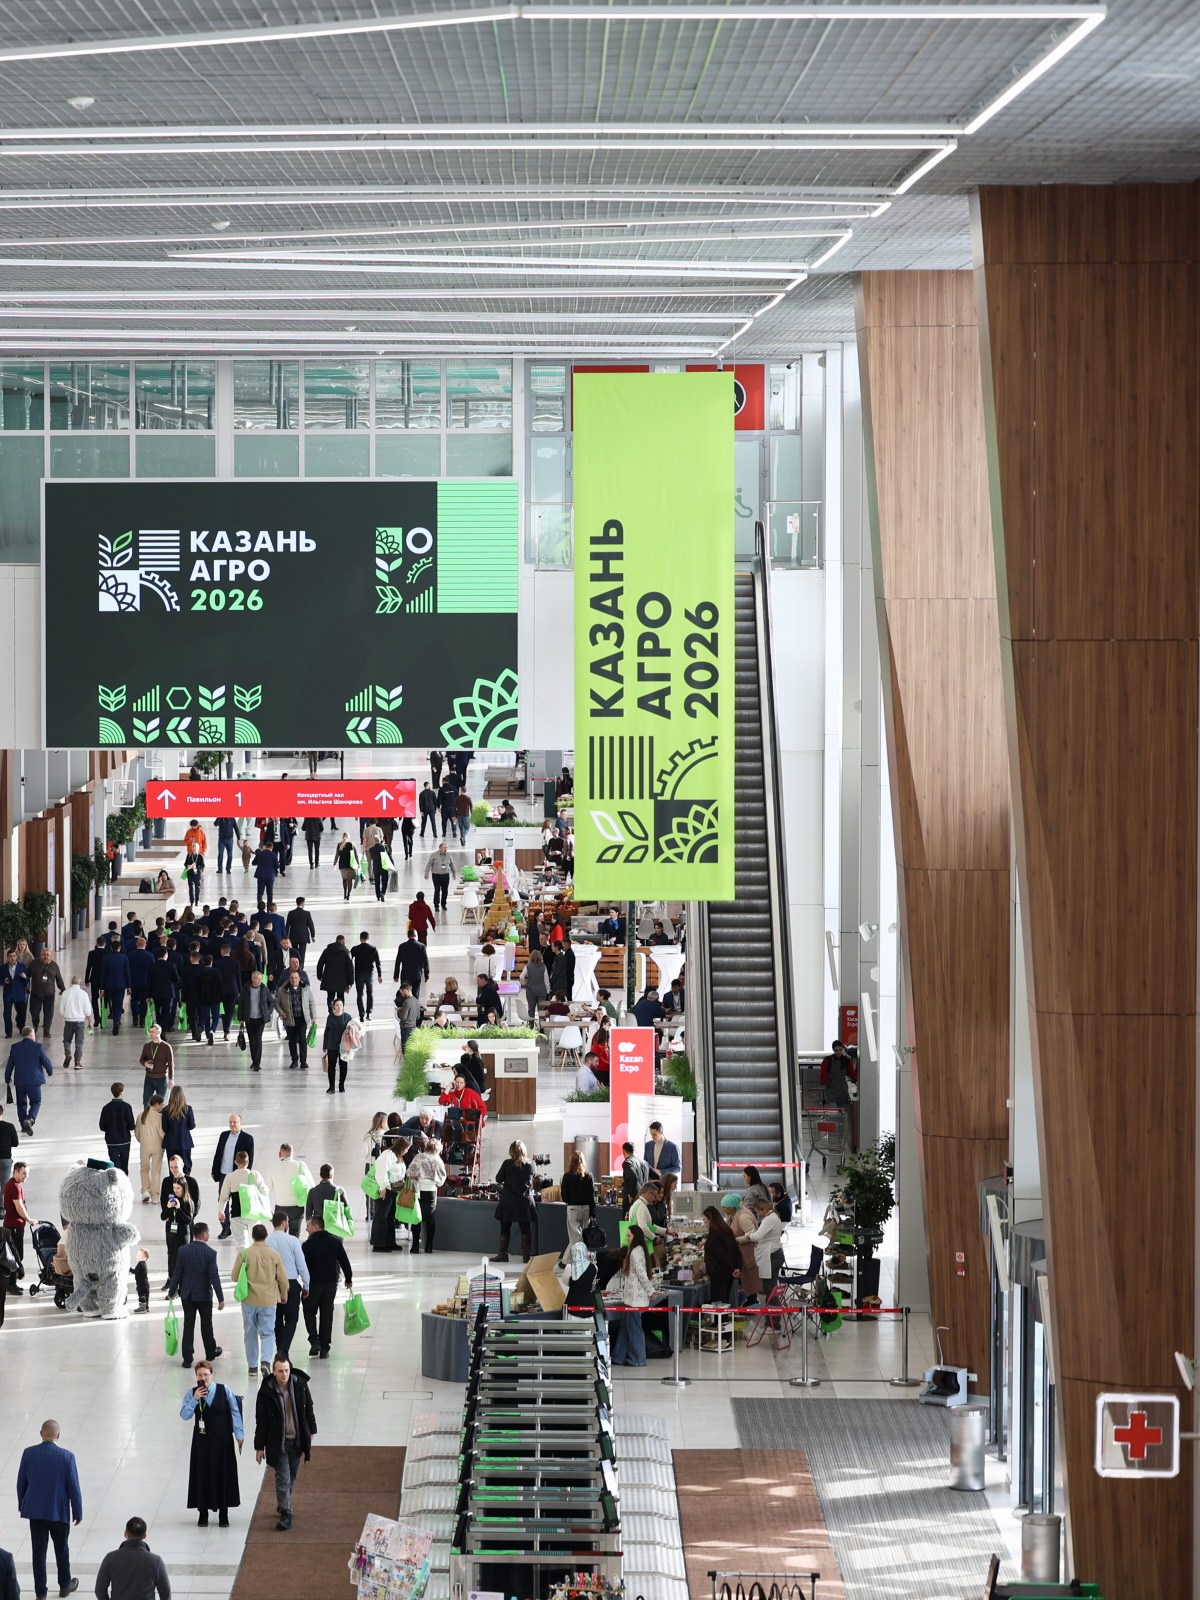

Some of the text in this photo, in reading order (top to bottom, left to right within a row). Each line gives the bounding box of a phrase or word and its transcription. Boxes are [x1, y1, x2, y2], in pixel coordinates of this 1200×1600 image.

[189, 530, 318, 553] КАЗАНЬ
[189, 558, 271, 582] АГРО
[190, 588, 264, 611] 2026
[589, 518, 625, 718] КАЗАНЬ
[636, 591, 672, 720] АГРО
[683, 601, 720, 719] 2026
[234, 791, 242, 807] 1
[619, 1054, 644, 1063] Kazan
[619, 1063, 640, 1074] Expo
